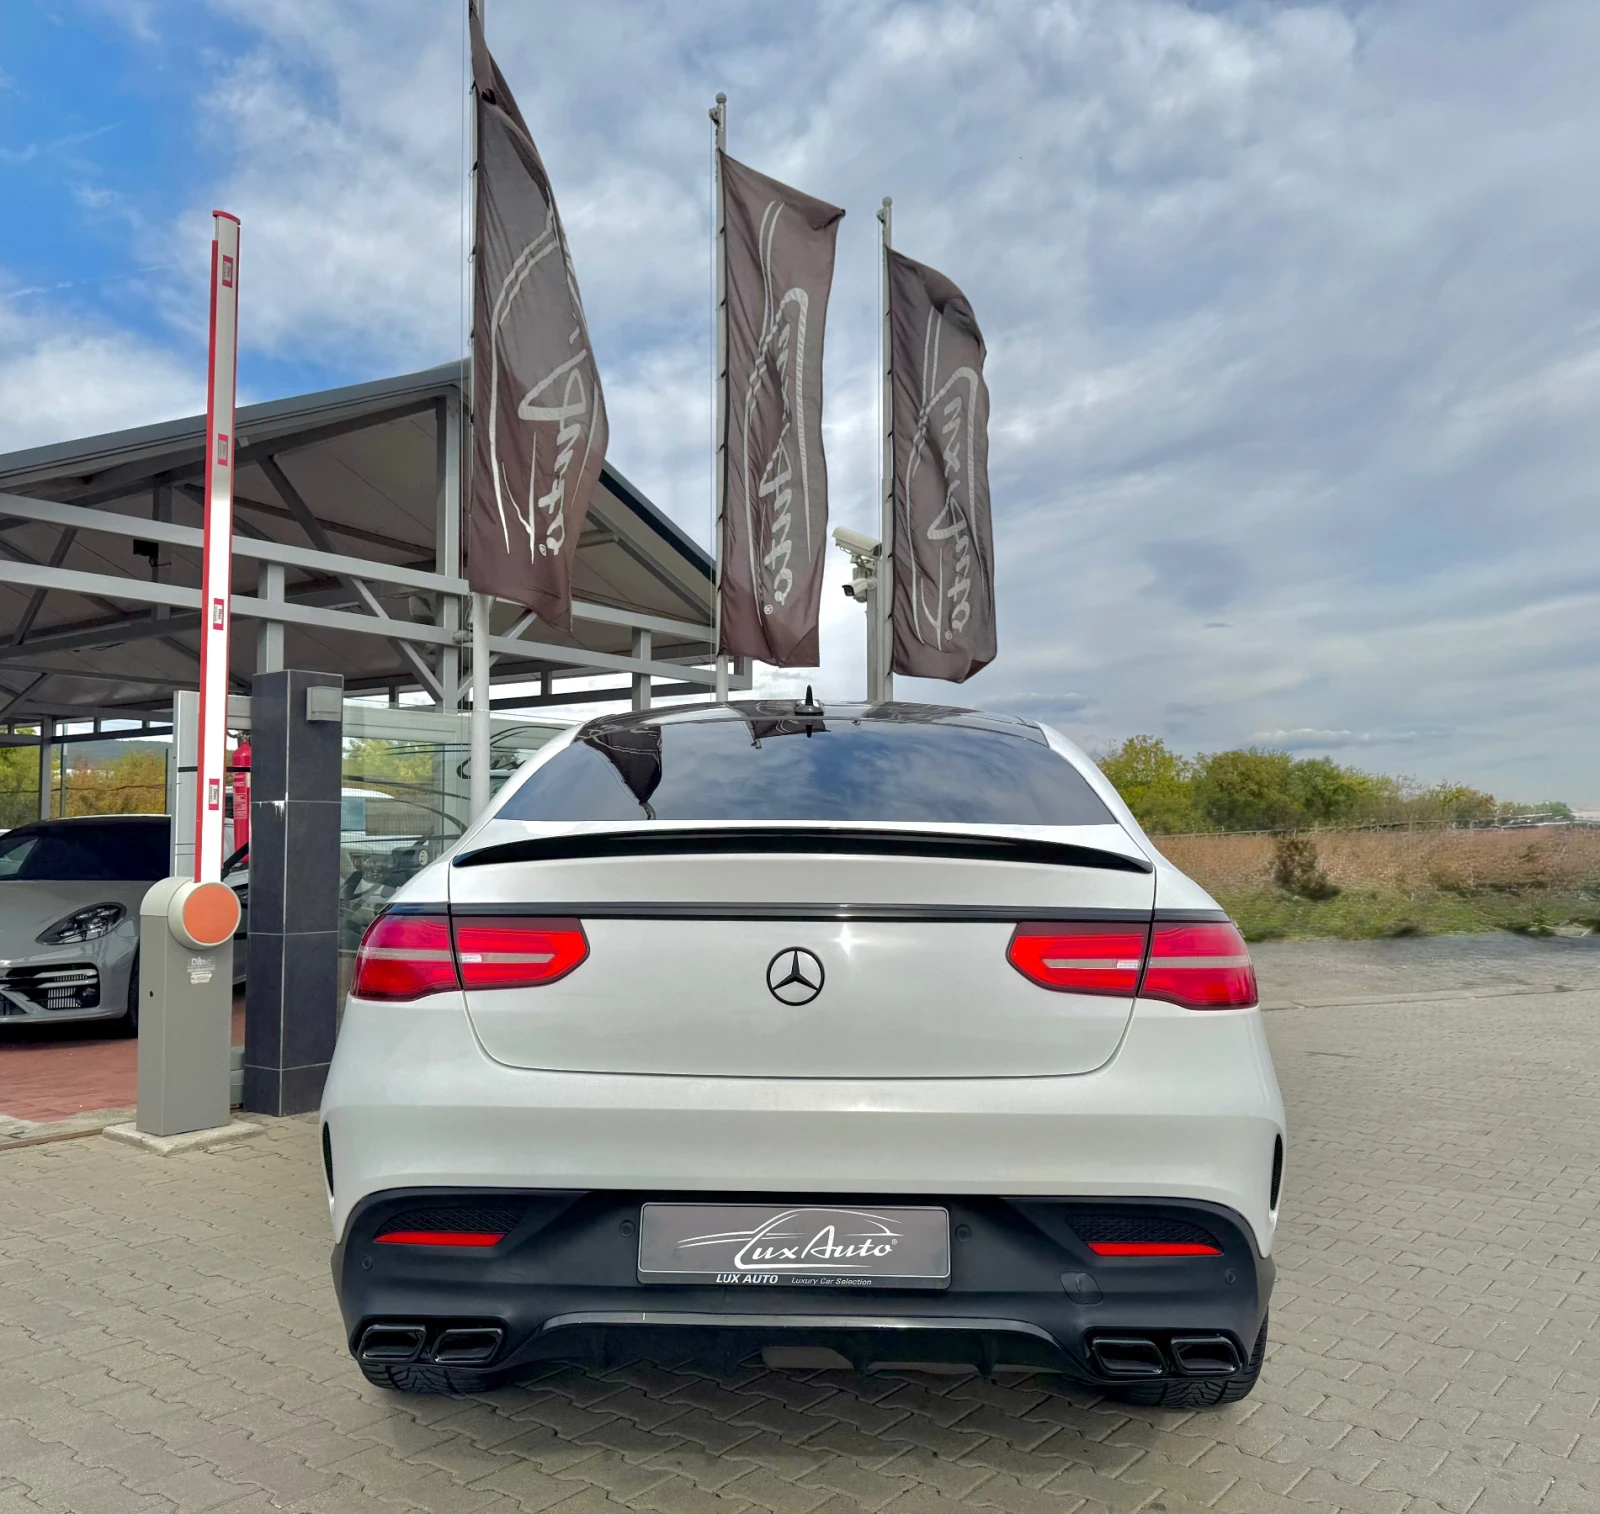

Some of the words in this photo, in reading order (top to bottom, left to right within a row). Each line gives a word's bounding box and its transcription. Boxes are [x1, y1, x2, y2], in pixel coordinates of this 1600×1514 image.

[715, 1273, 739, 1284] LUX
[742, 1274, 779, 1285] AUTO
[791, 1277, 818, 1286] Luxury
[820, 1277, 834, 1286] Car
[835, 1277, 872, 1287] Selection
